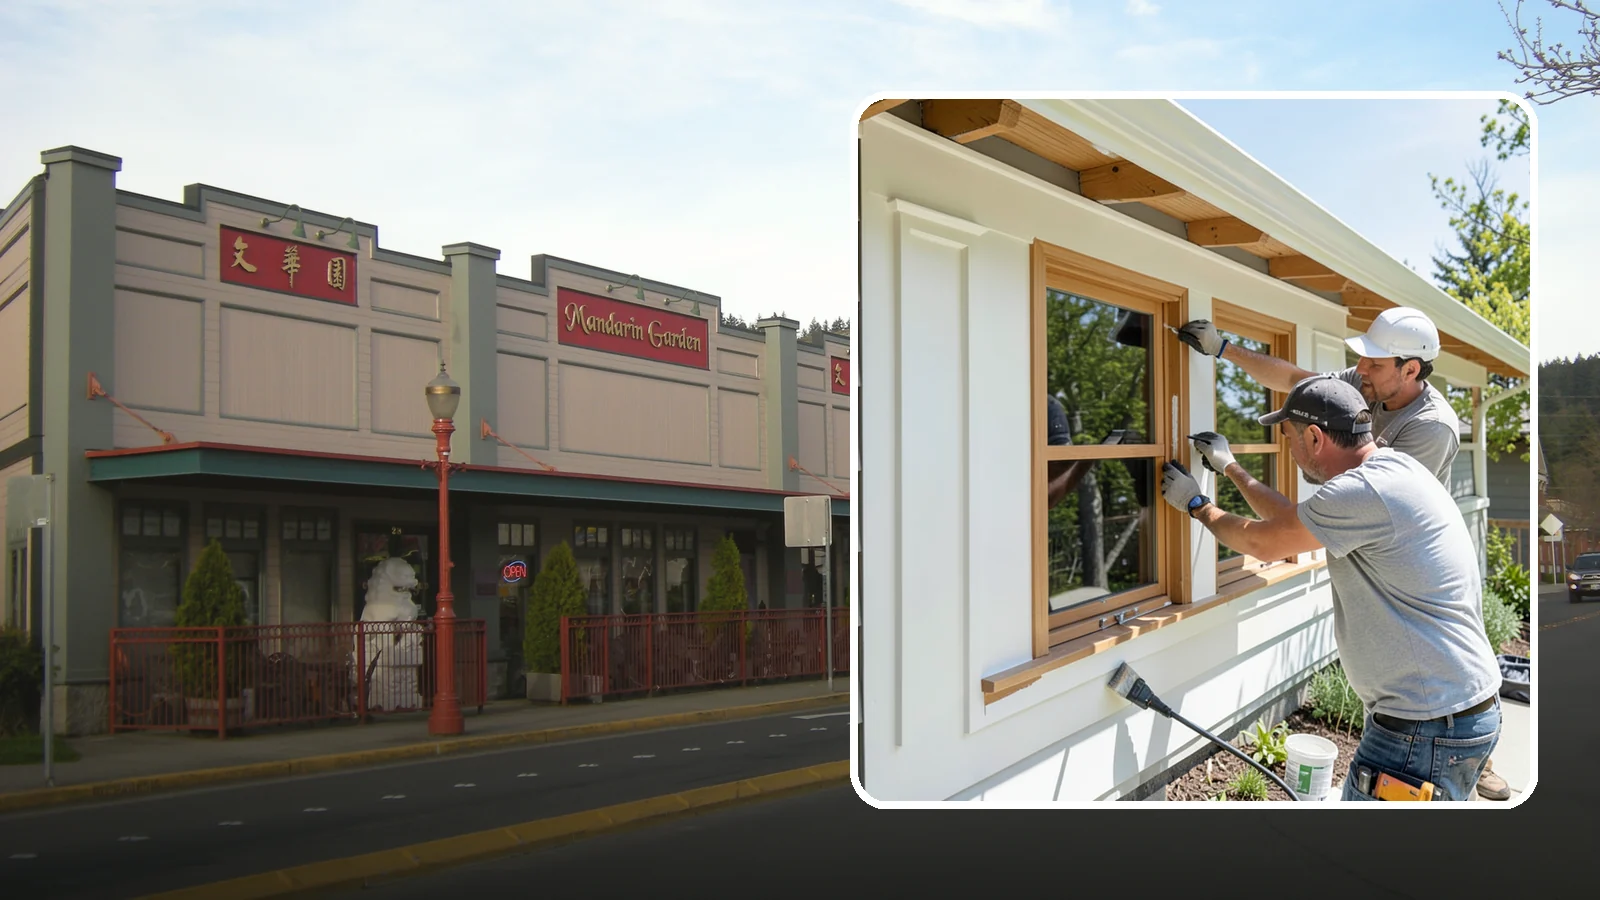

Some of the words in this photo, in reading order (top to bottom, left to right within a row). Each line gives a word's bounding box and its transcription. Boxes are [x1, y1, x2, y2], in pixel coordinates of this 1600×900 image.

[231, 236, 346, 291] 文華園
[565, 302, 644, 341] Mandarin
[648, 320, 701, 352] Garden
[503, 565, 527, 578] OPEN
